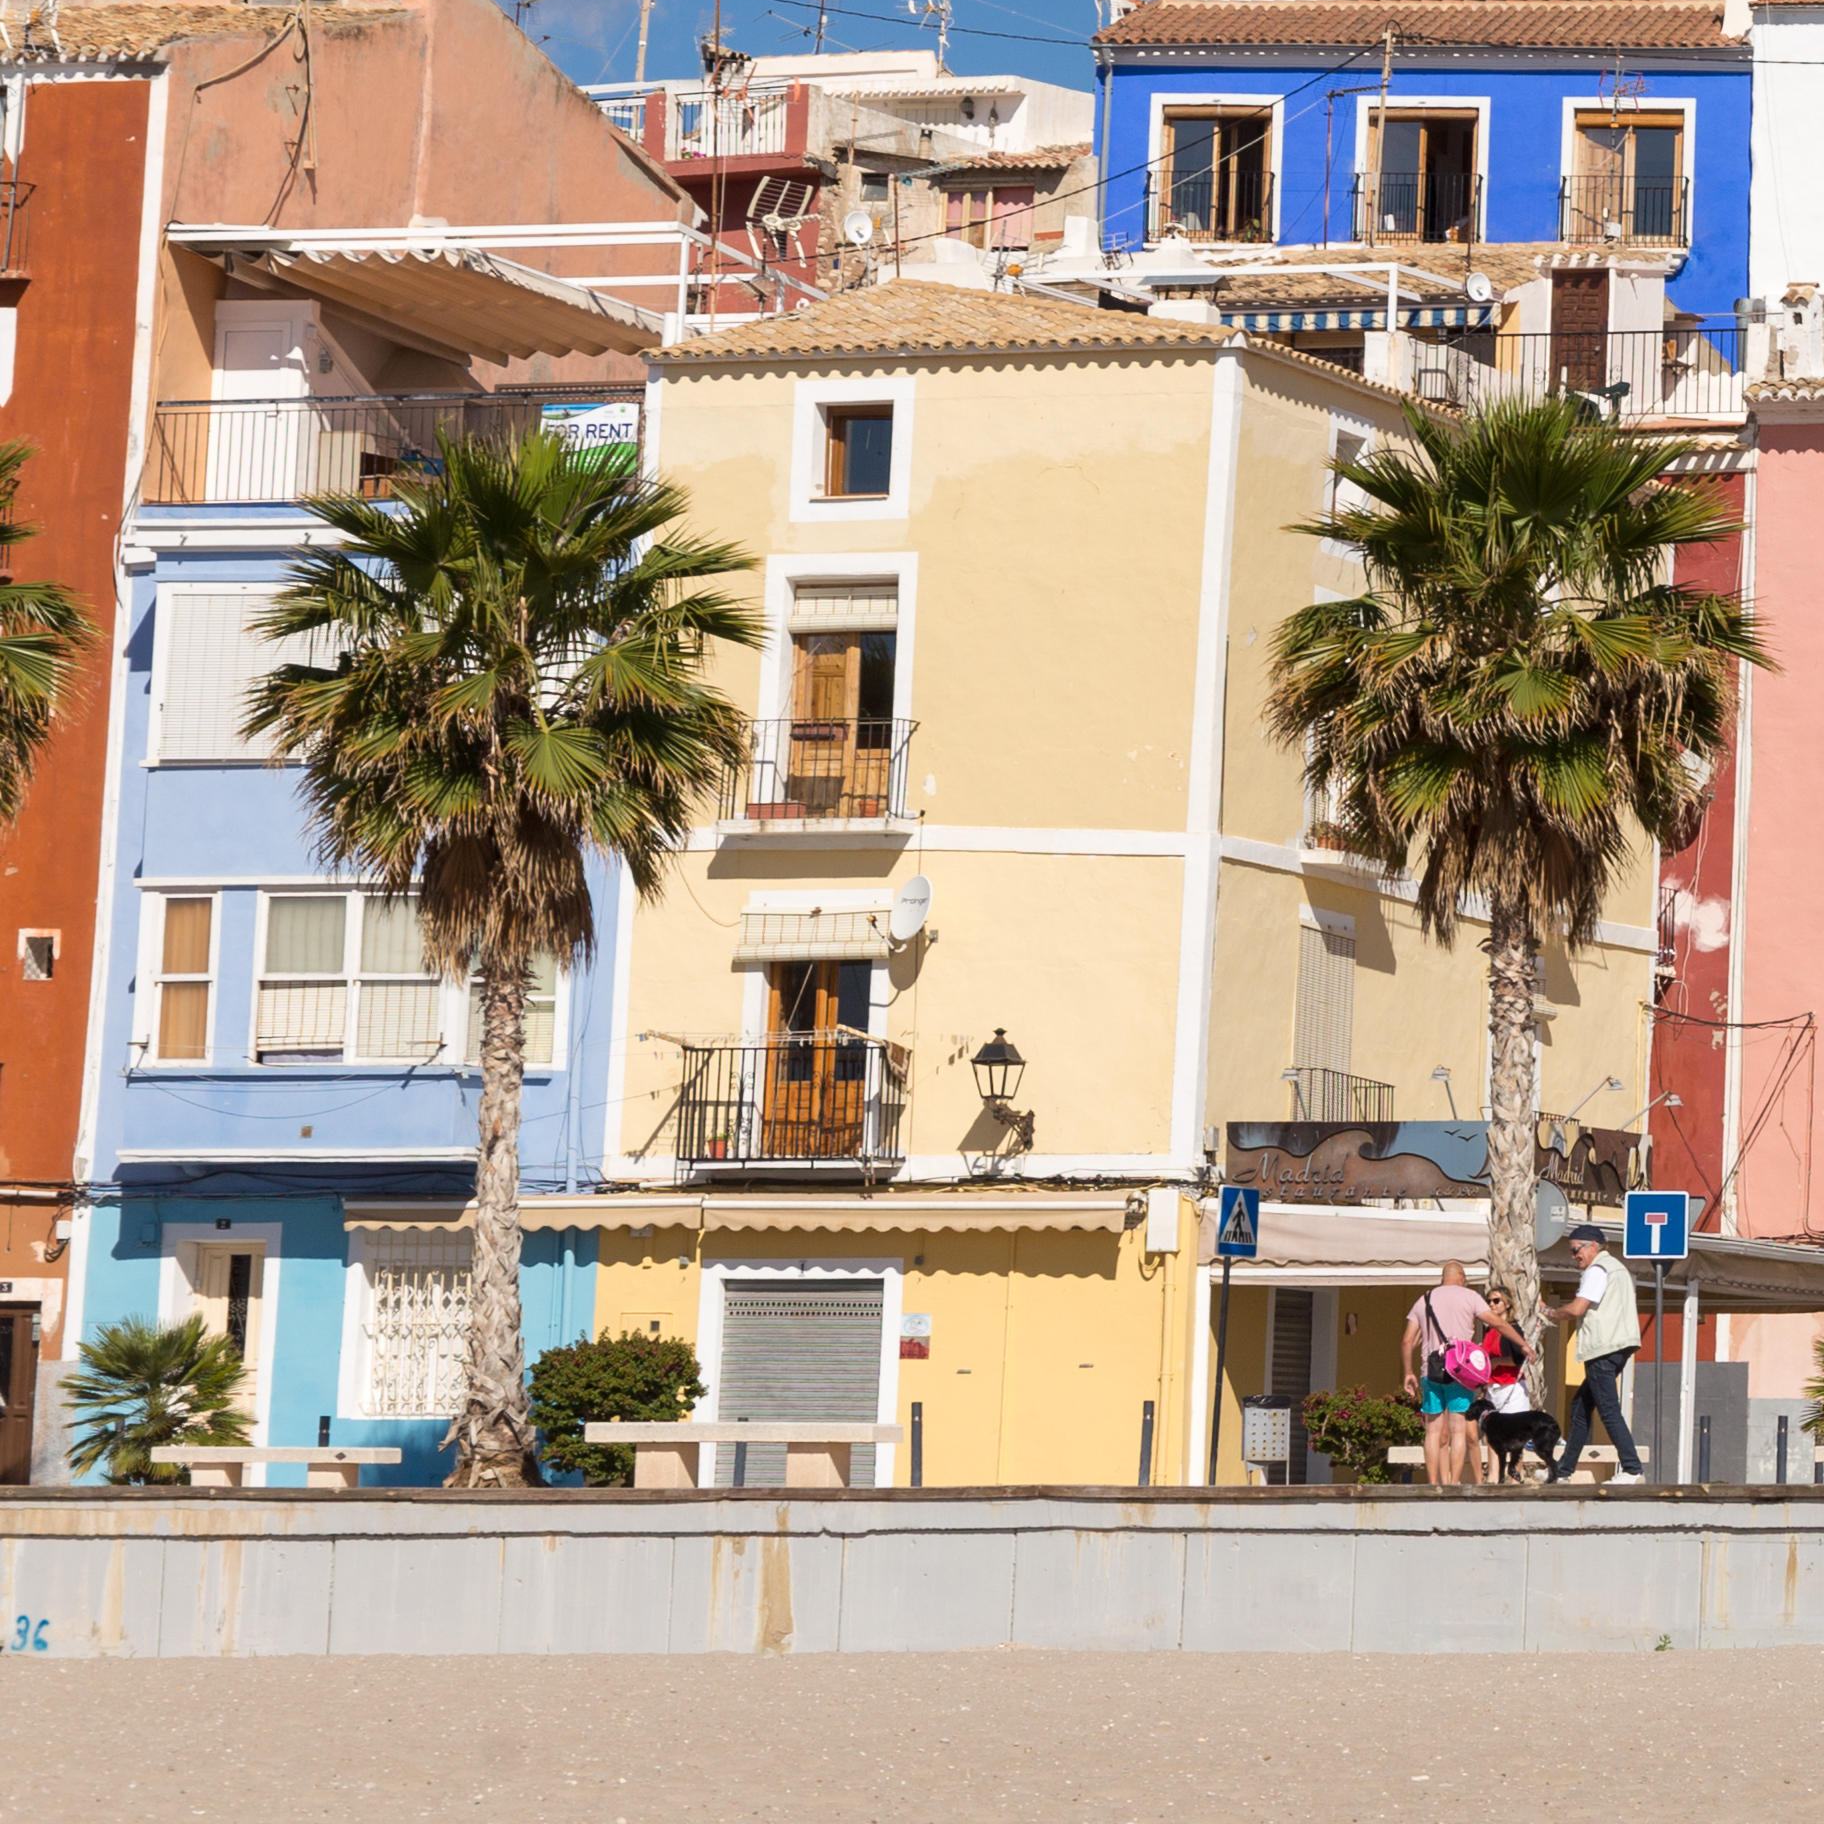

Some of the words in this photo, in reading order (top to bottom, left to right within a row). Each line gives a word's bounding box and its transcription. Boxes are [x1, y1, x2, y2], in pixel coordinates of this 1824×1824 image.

[586, 423, 633, 439] RENT
[1232, 1152, 1349, 1186] Madrid
[1540, 1151, 1584, 1185] Madrid
[1263, 1185, 1407, 1198] staurante
